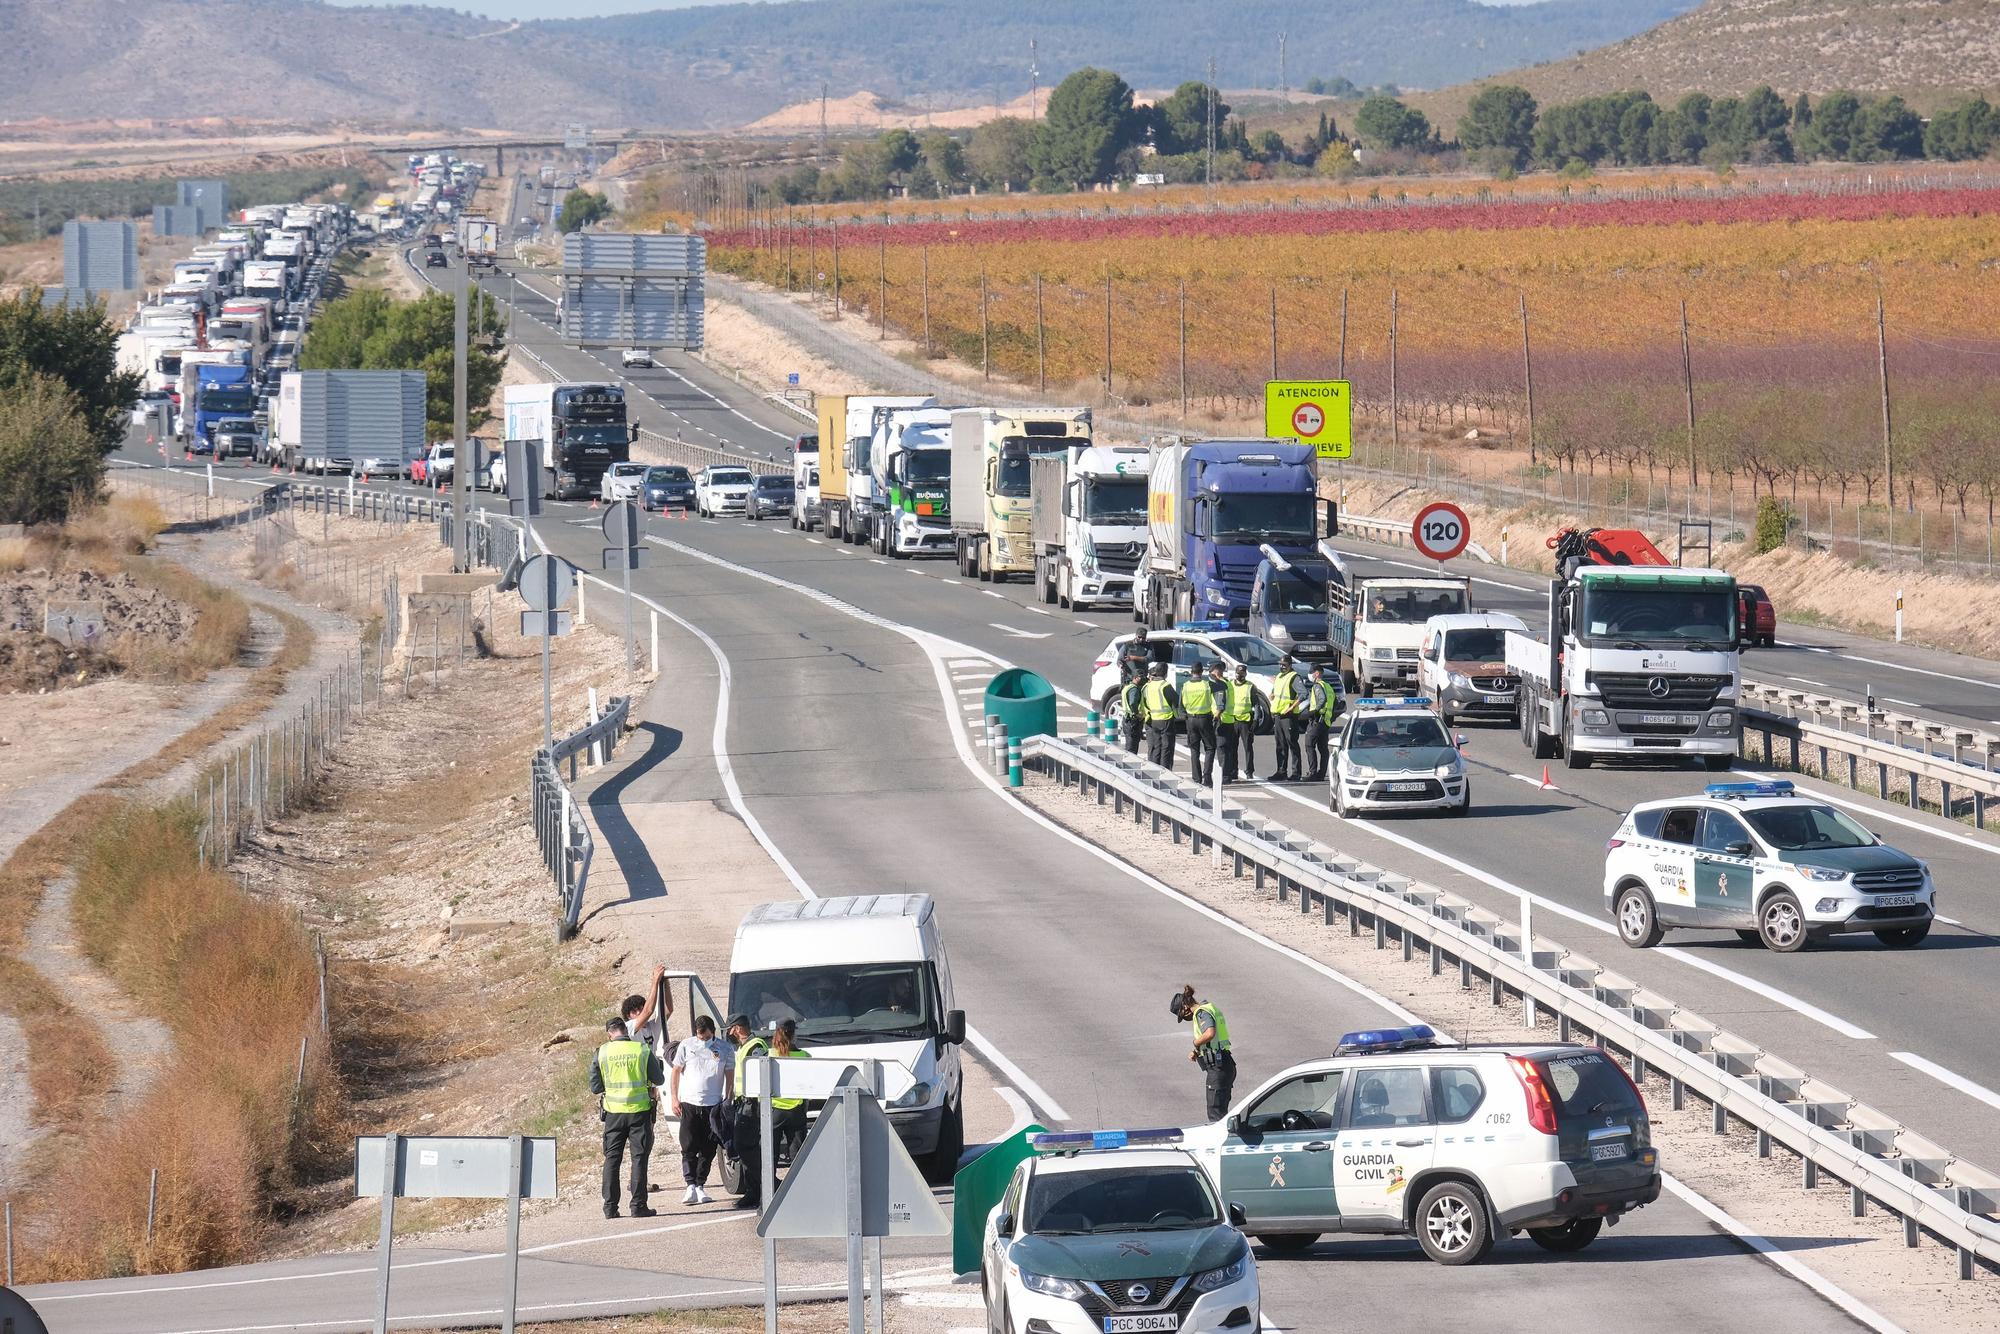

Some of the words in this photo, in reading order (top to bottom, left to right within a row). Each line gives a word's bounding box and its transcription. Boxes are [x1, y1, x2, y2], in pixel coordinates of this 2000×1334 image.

[1308, 443, 1342, 452] IEVE
[1423, 522, 1460, 540] 120
[1653, 863, 1684, 876] GUARDIA
[1660, 876, 1677, 887] CIVIL
[1493, 1113, 1511, 1124] 062
[1093, 1132, 1126, 1140] GUARDIA
[1343, 1154, 1395, 1166] GUARDIA
[1355, 1169, 1385, 1180] CIVIL
[1111, 1318, 1133, 1331] PGC
[1136, 1316, 1165, 1330] 9064
[1168, 1315, 1177, 1328] N
